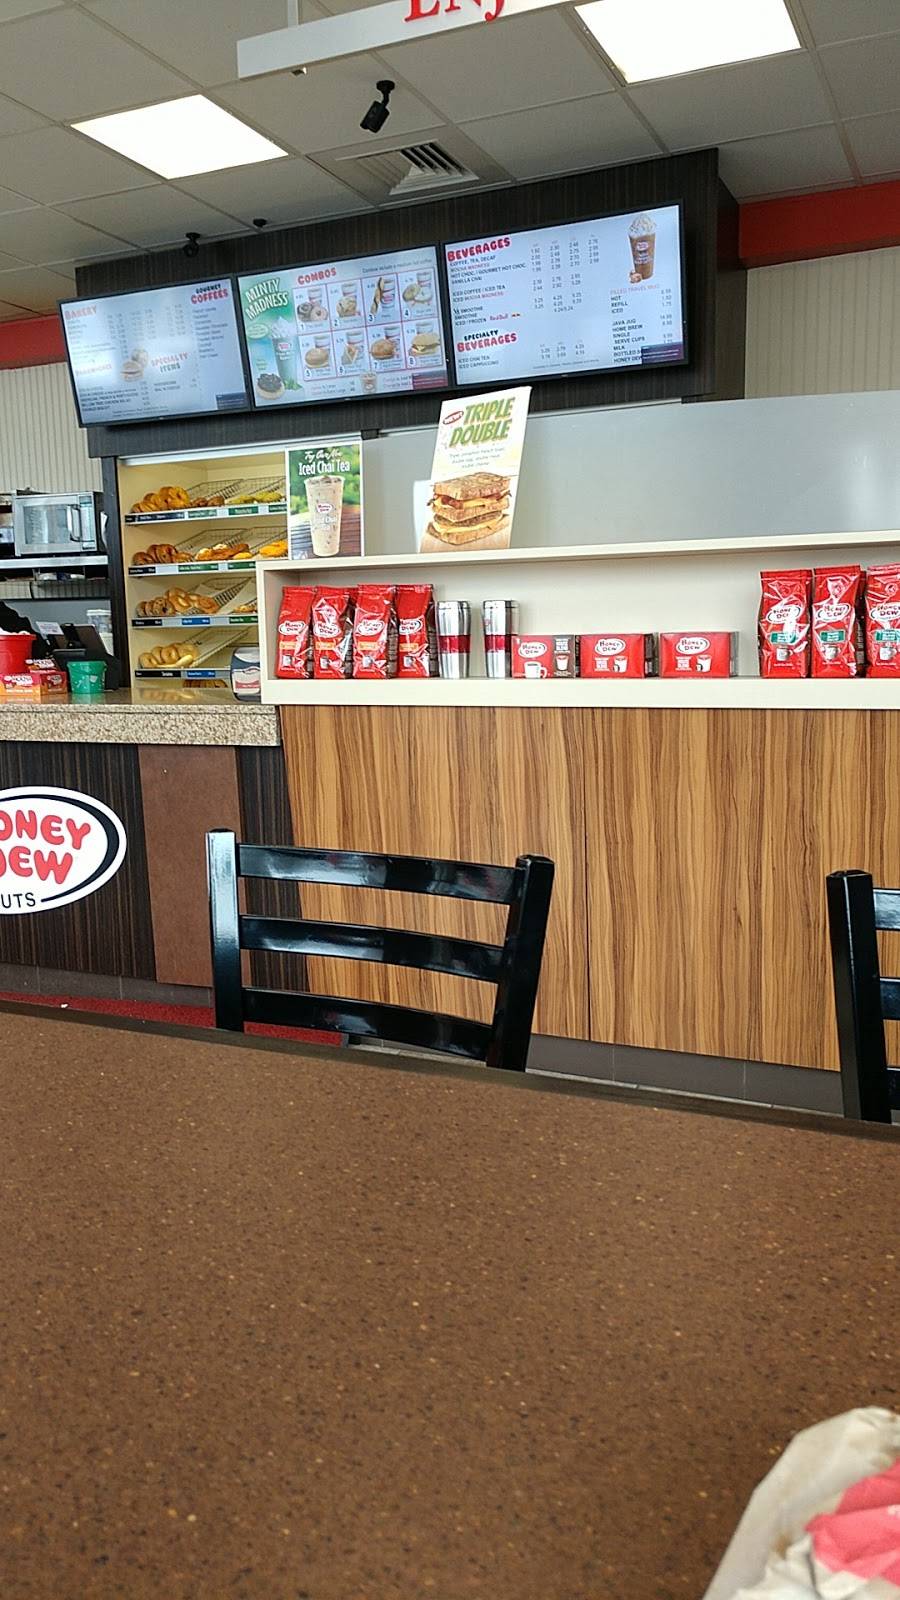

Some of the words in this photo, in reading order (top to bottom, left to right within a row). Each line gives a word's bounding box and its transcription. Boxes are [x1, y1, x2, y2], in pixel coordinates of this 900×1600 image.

[447, 236, 511, 263] BEVERAGES
[298, 266, 337, 286] COMBOS
[190, 288, 228, 304] COFFEES
[245, 278, 280, 303] MINTY
[65, 304, 97, 320] BAKERY
[245, 292, 289, 320] MADNESS
[456, 332, 518, 353] BEVERAGES
[464, 330, 499, 342] SPECIALTY
[464, 397, 515, 426] TRIPLE
[449, 418, 513, 448] DOUBLE
[304, 450, 315, 464] Try
[298, 462, 316, 476] Iced
[317, 459, 335, 474] Chai
[336, 458, 350, 472] Tea
[522, 643, 542, 651] HONEY
[600, 640, 620, 648] HONEY
[682, 638, 704, 647] HONEY
[0, 845, 74, 885] EW
[1, 892, 37, 909] UTS
